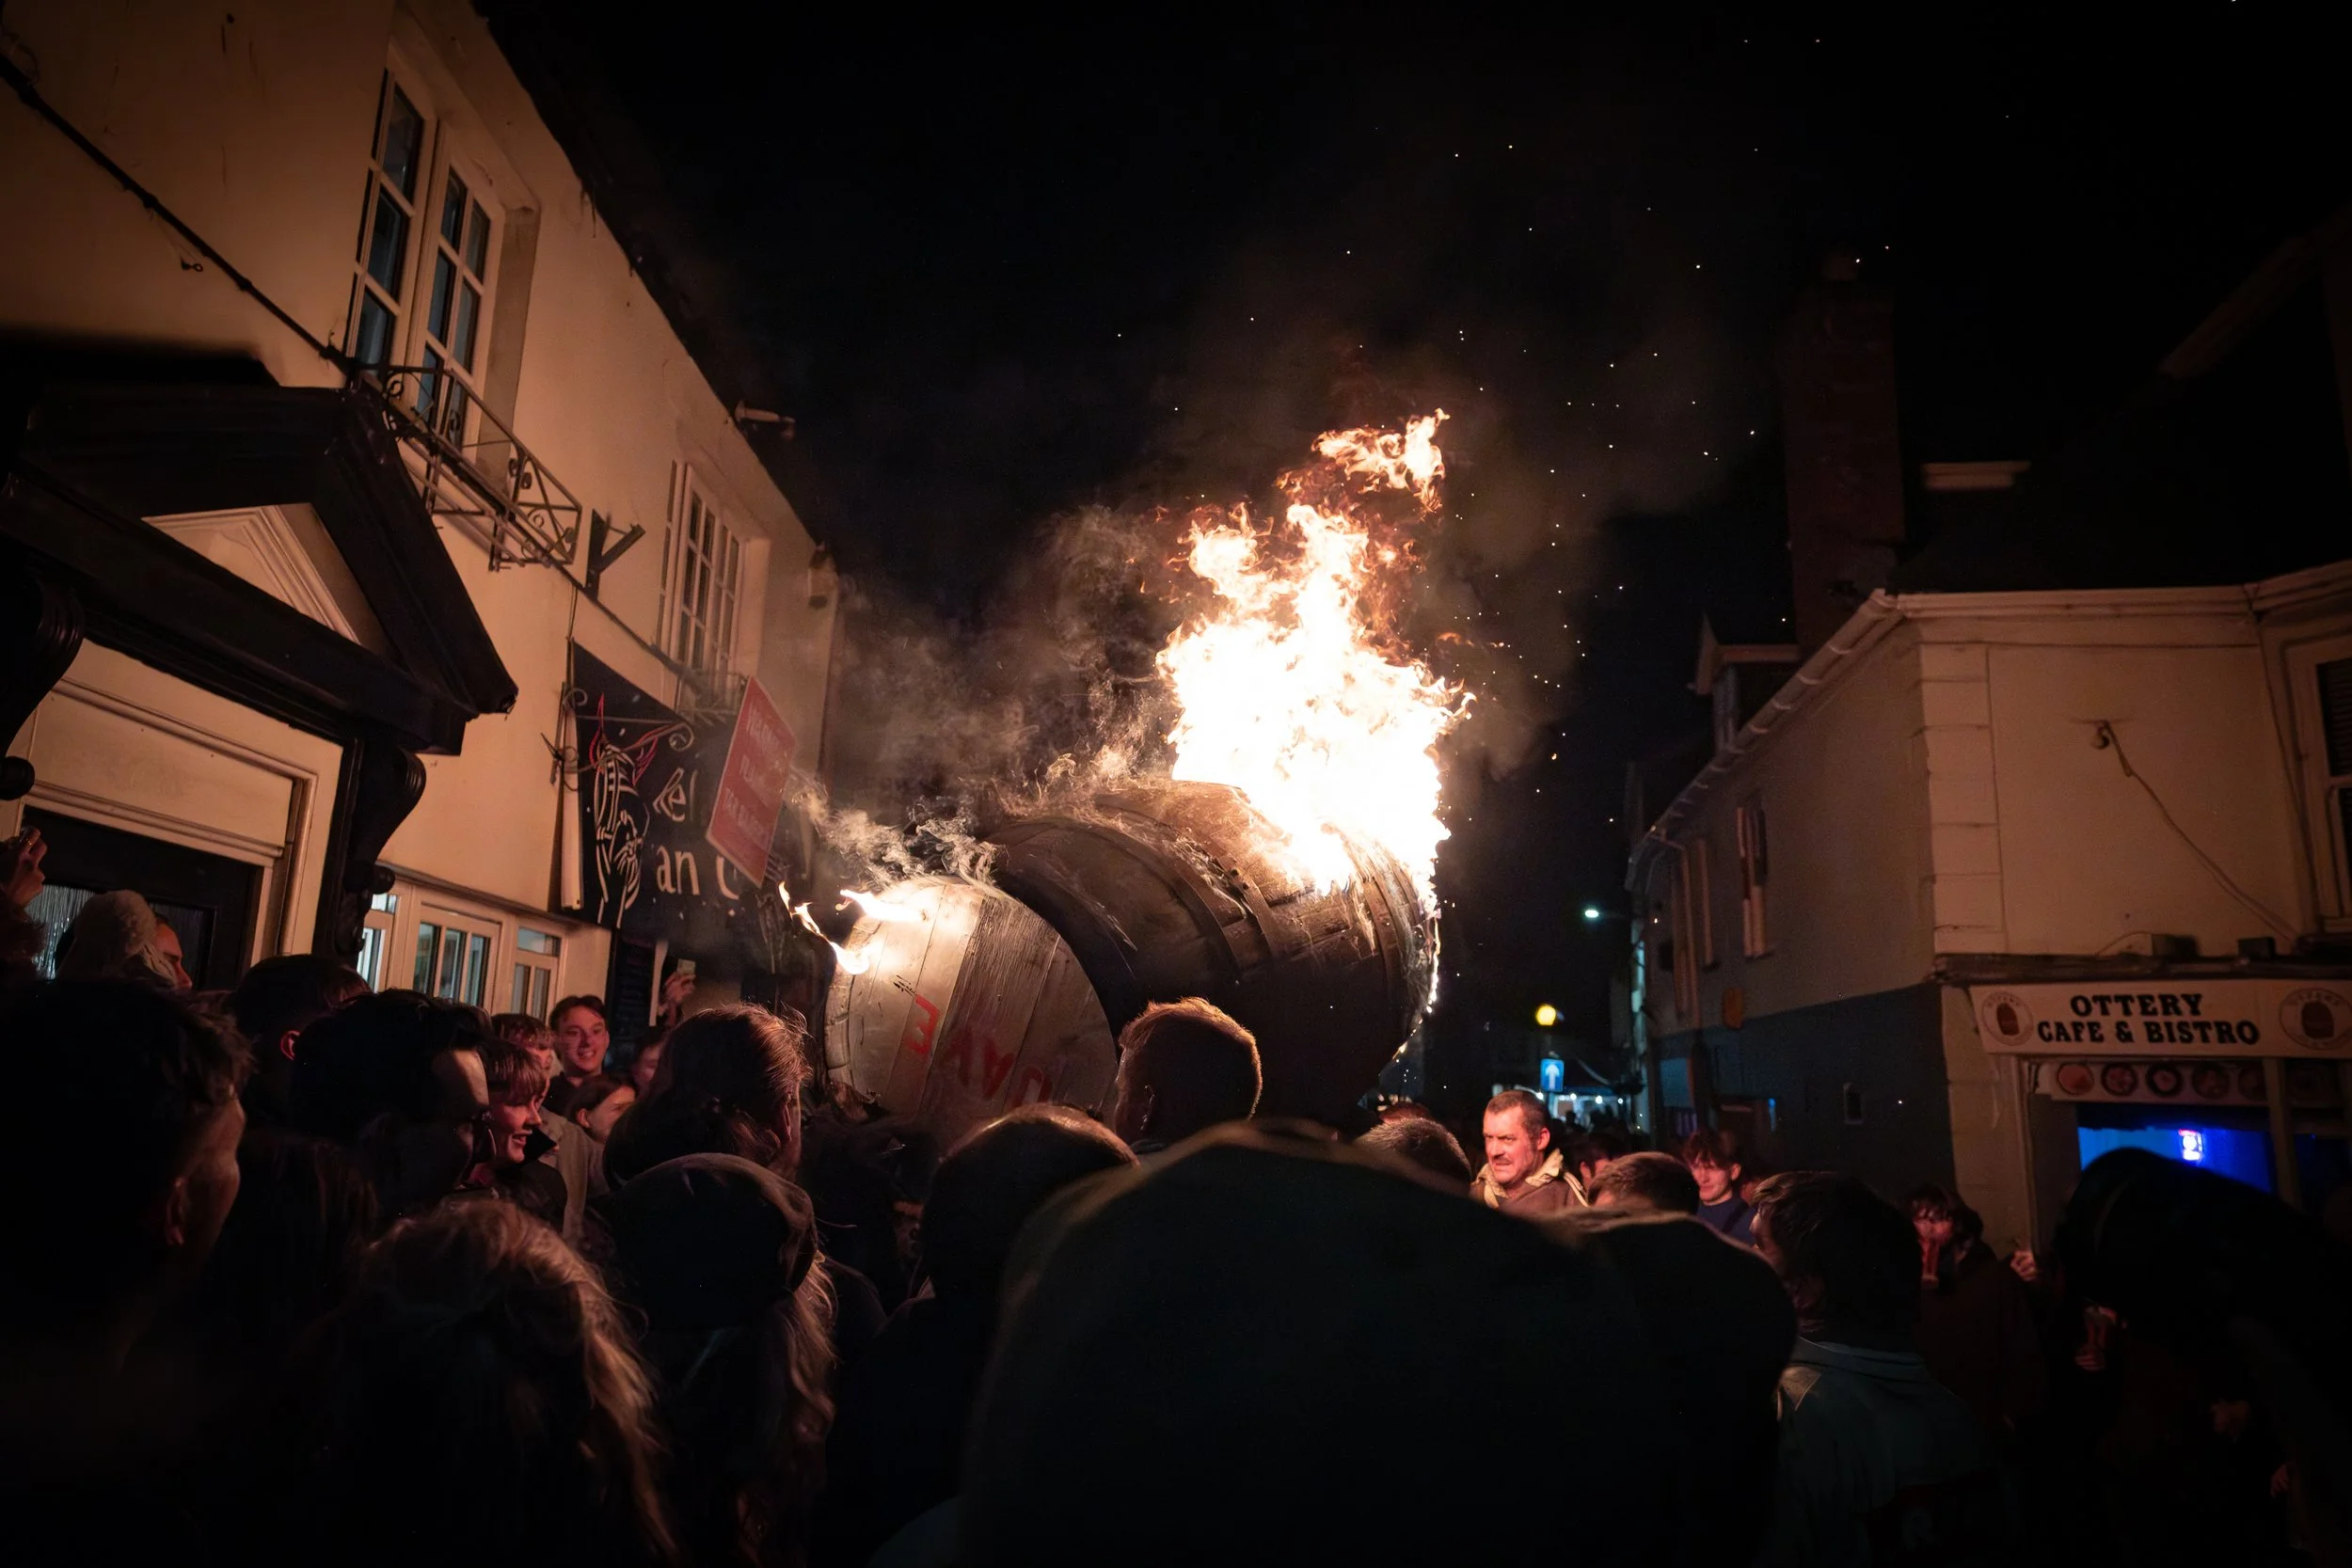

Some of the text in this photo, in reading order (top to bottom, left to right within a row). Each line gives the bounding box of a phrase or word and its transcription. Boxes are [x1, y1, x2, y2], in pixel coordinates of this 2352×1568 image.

[2070, 992, 2203, 1018] OTTERY
[2037, 1020, 2261, 1045] CAFE & BISTRO
